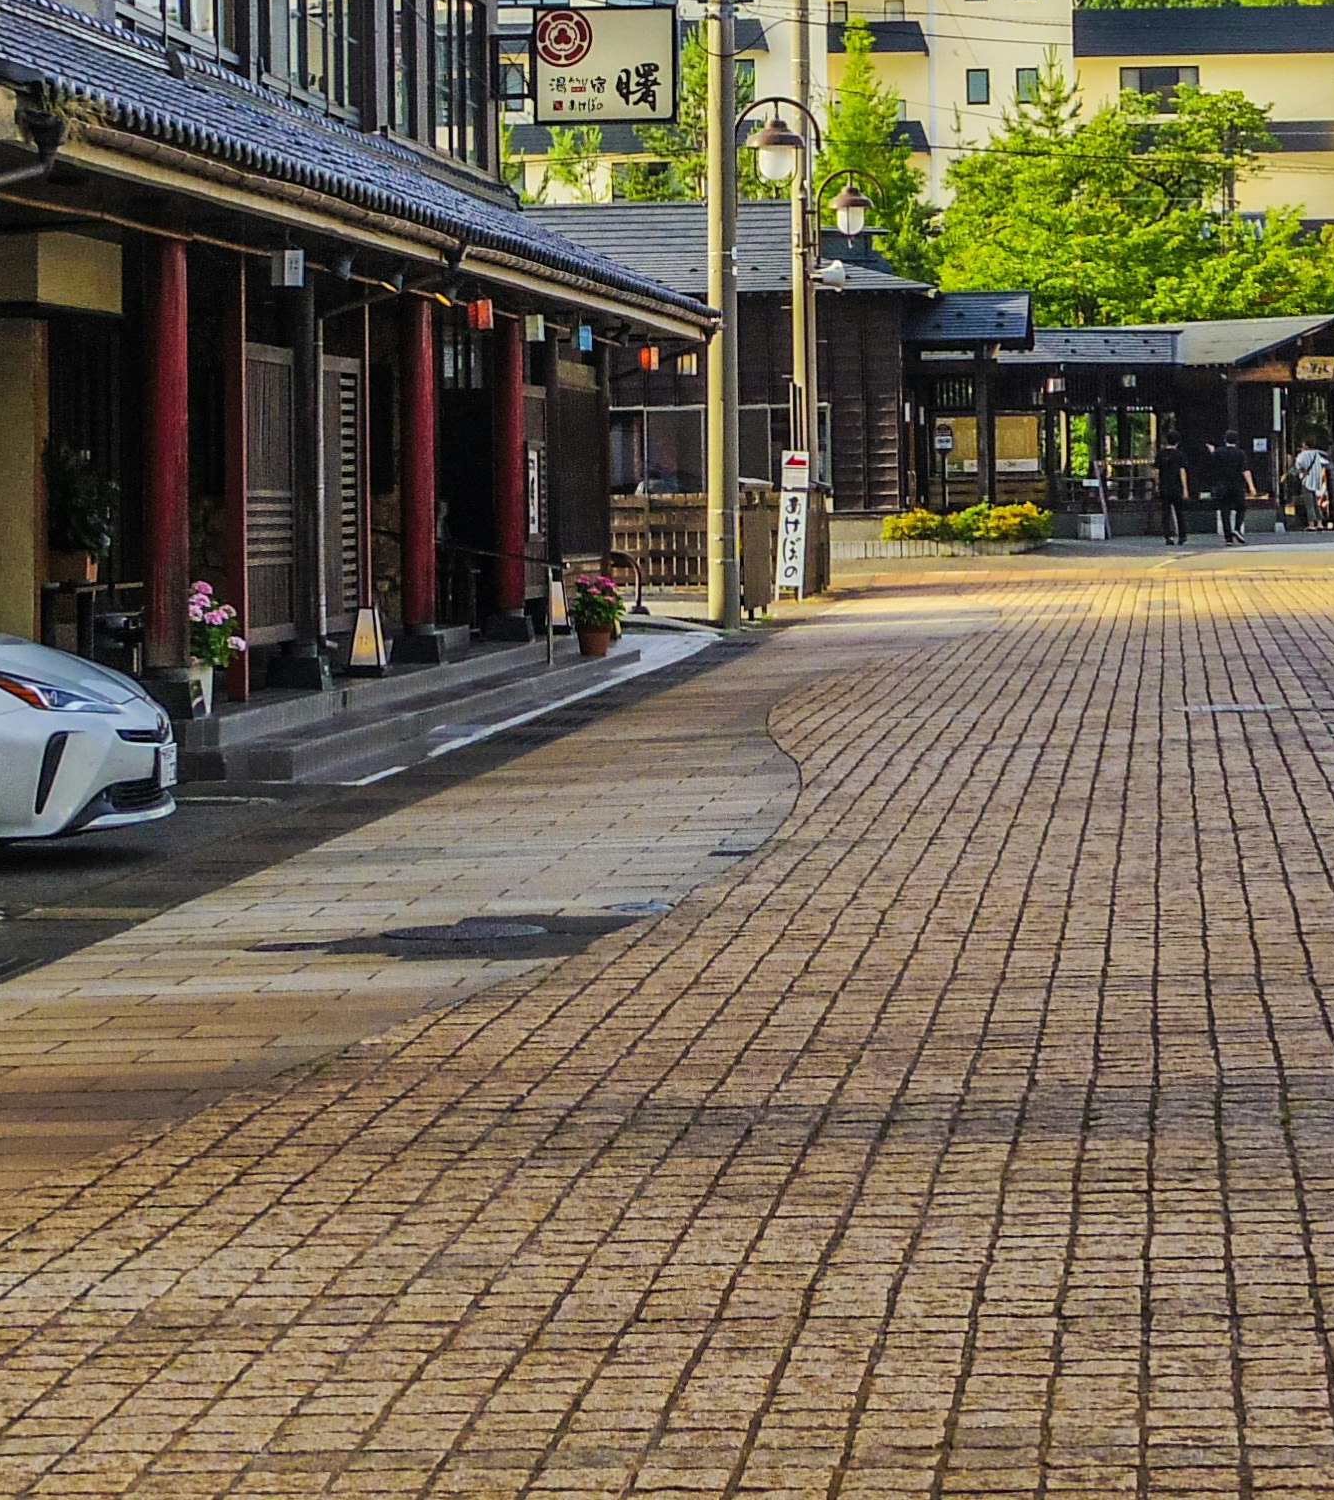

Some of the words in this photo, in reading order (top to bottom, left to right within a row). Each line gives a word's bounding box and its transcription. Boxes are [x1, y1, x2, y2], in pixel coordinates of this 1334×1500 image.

[616, 63, 662, 112] 曙
[782, 496, 802, 578] あけぼの
